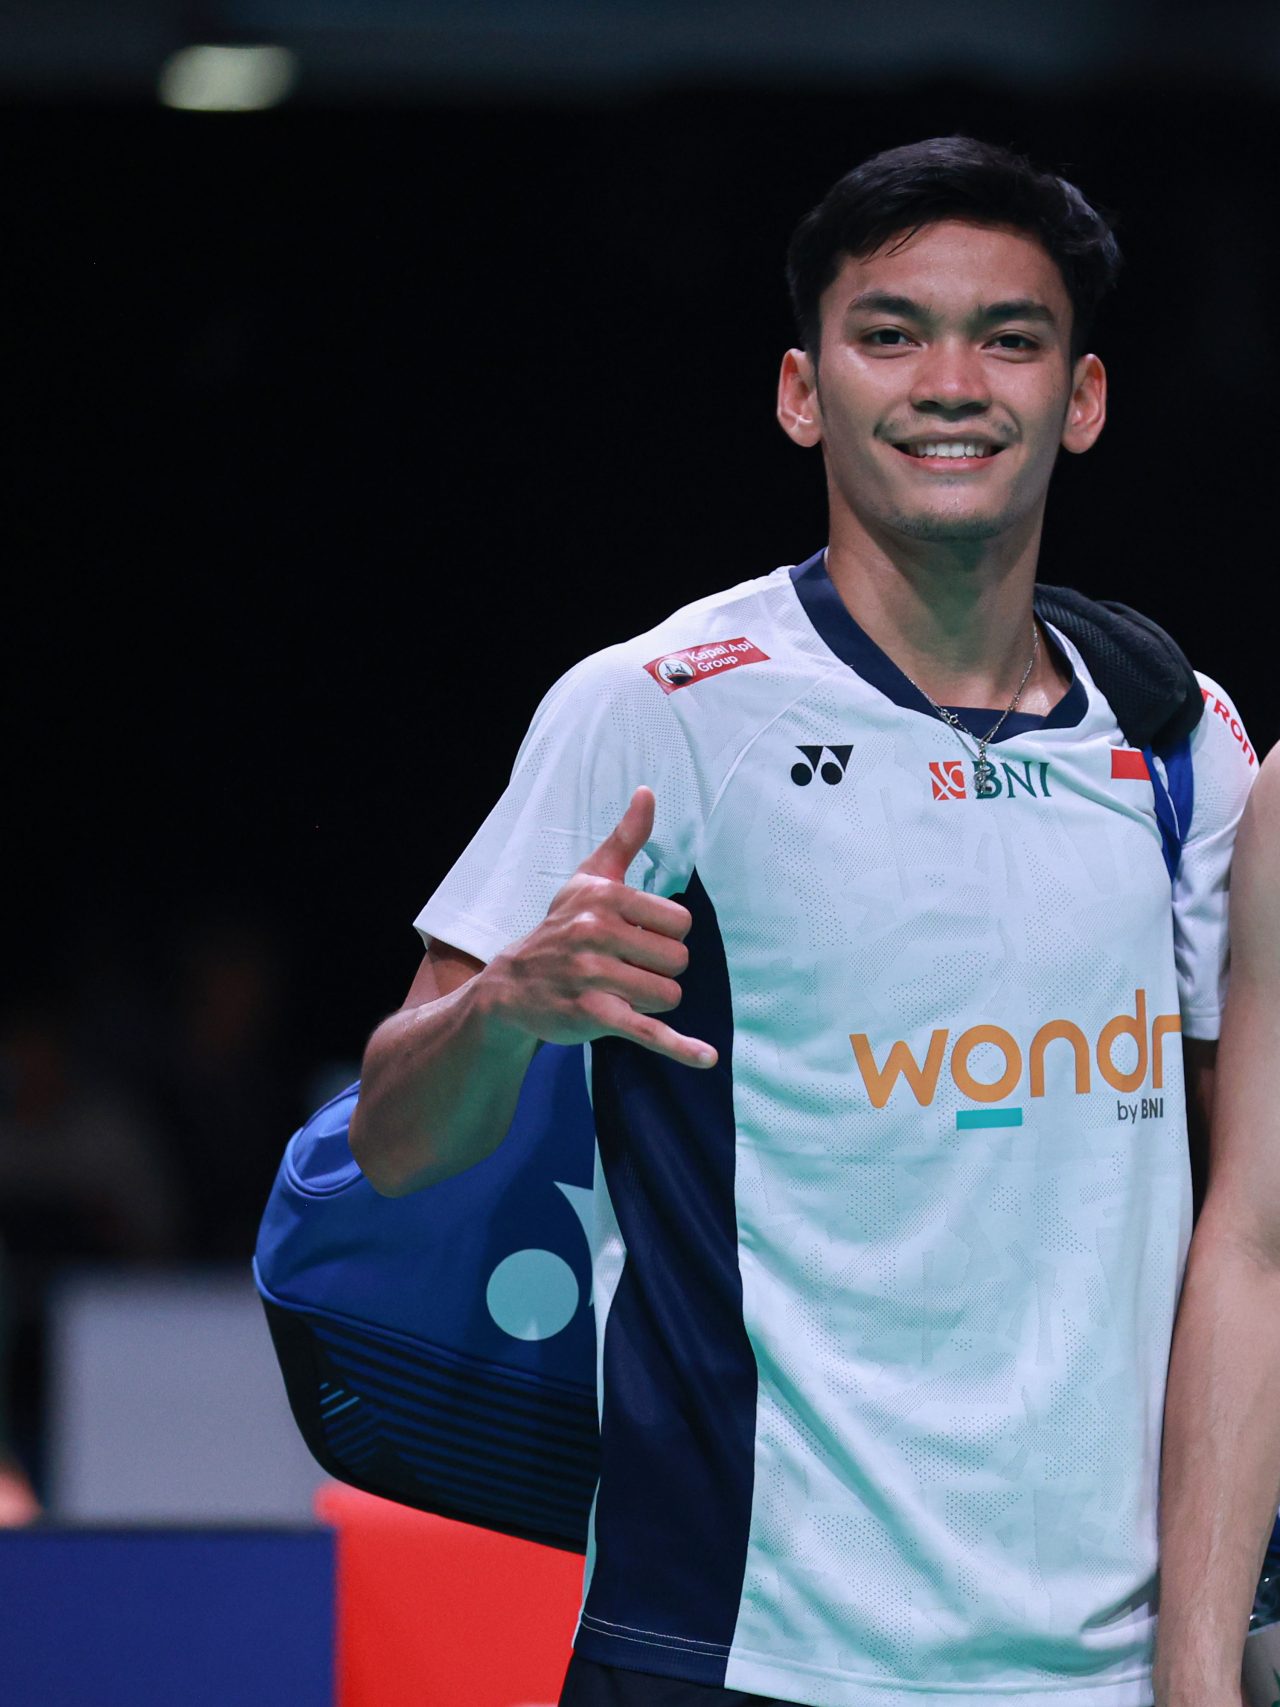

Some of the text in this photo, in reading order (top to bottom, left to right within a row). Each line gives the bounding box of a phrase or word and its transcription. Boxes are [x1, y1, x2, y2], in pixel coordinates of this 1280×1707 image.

[687, 640, 754, 663] Kapal Api
[697, 655, 738, 673] Group
[972, 760, 1052, 799] BNI
[849, 988, 1182, 1109] wondr
[1117, 1097, 1164, 1124] by BNI
